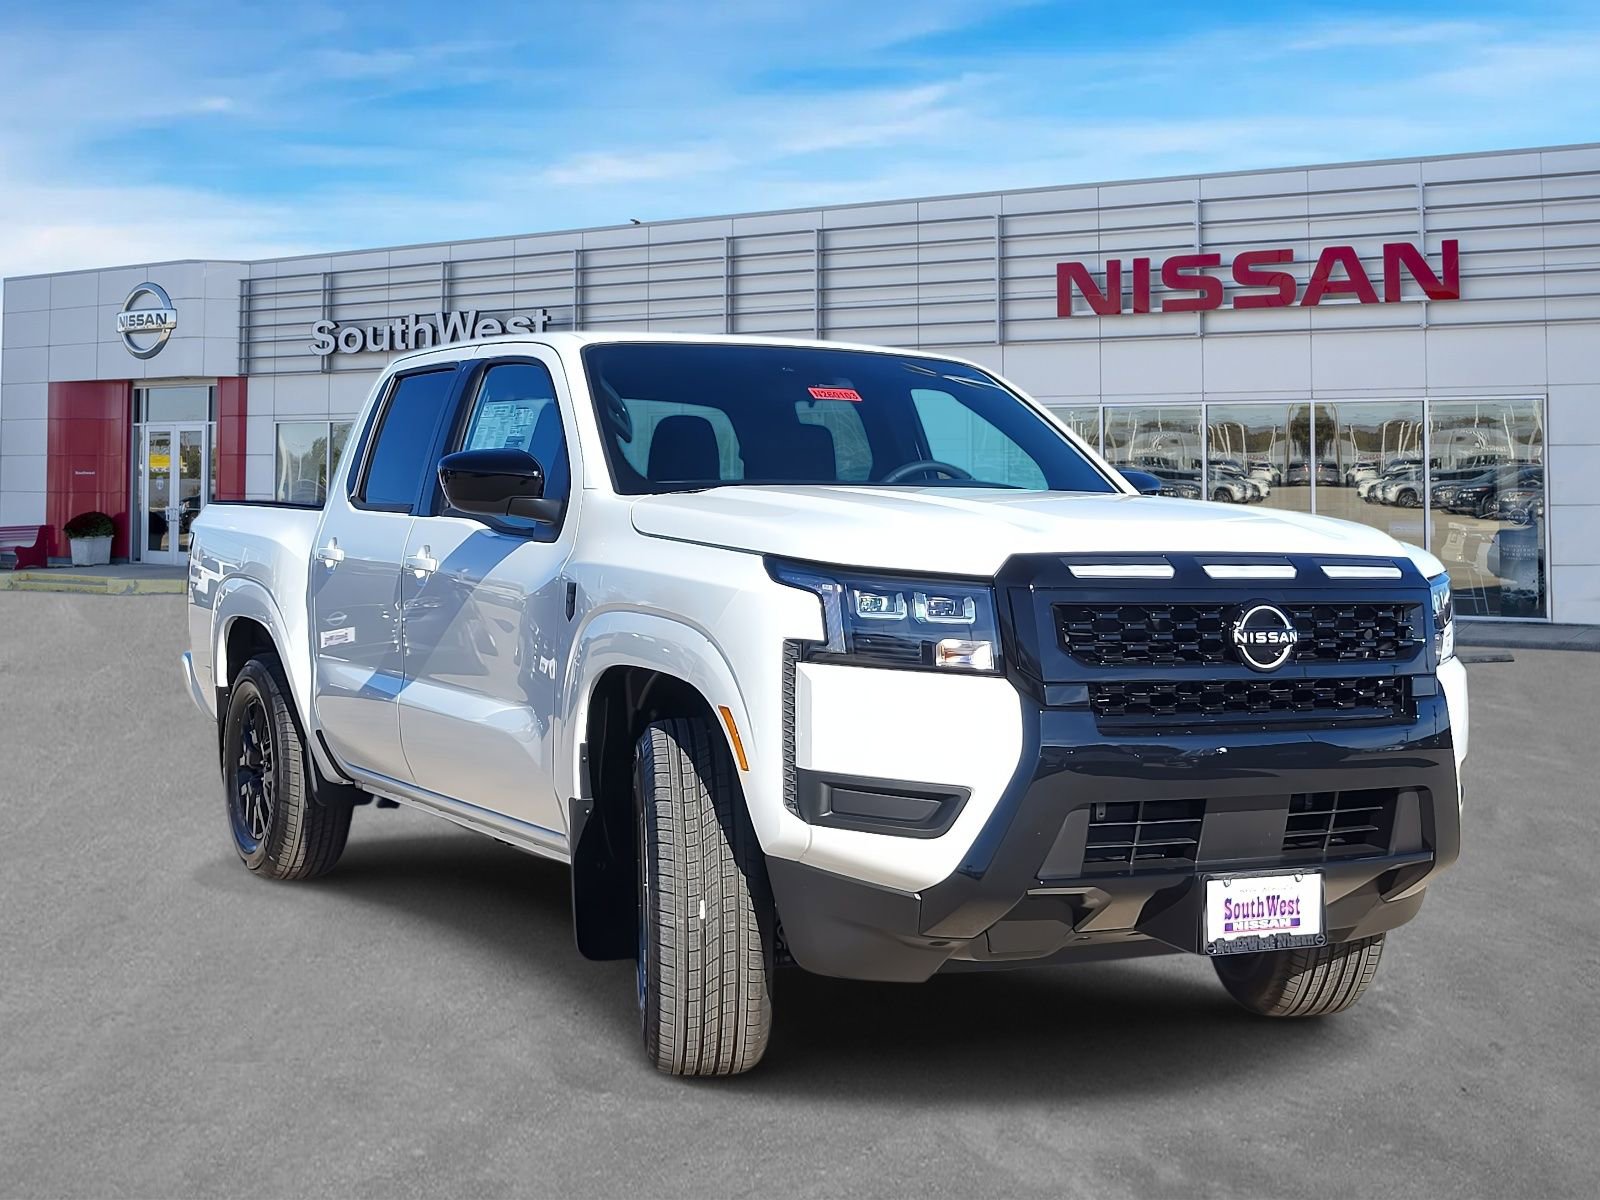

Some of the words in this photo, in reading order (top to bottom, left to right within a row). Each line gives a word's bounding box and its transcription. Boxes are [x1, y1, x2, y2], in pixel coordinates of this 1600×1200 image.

[1057, 239, 1460, 318] NISSAN
[119, 312, 168, 328] NISSAN
[309, 309, 552, 356] SouthWest
[1233, 630, 1298, 644] NISSAN
[1224, 895, 1300, 920] SouthWest
[1232, 918, 1288, 932] NISSAN
